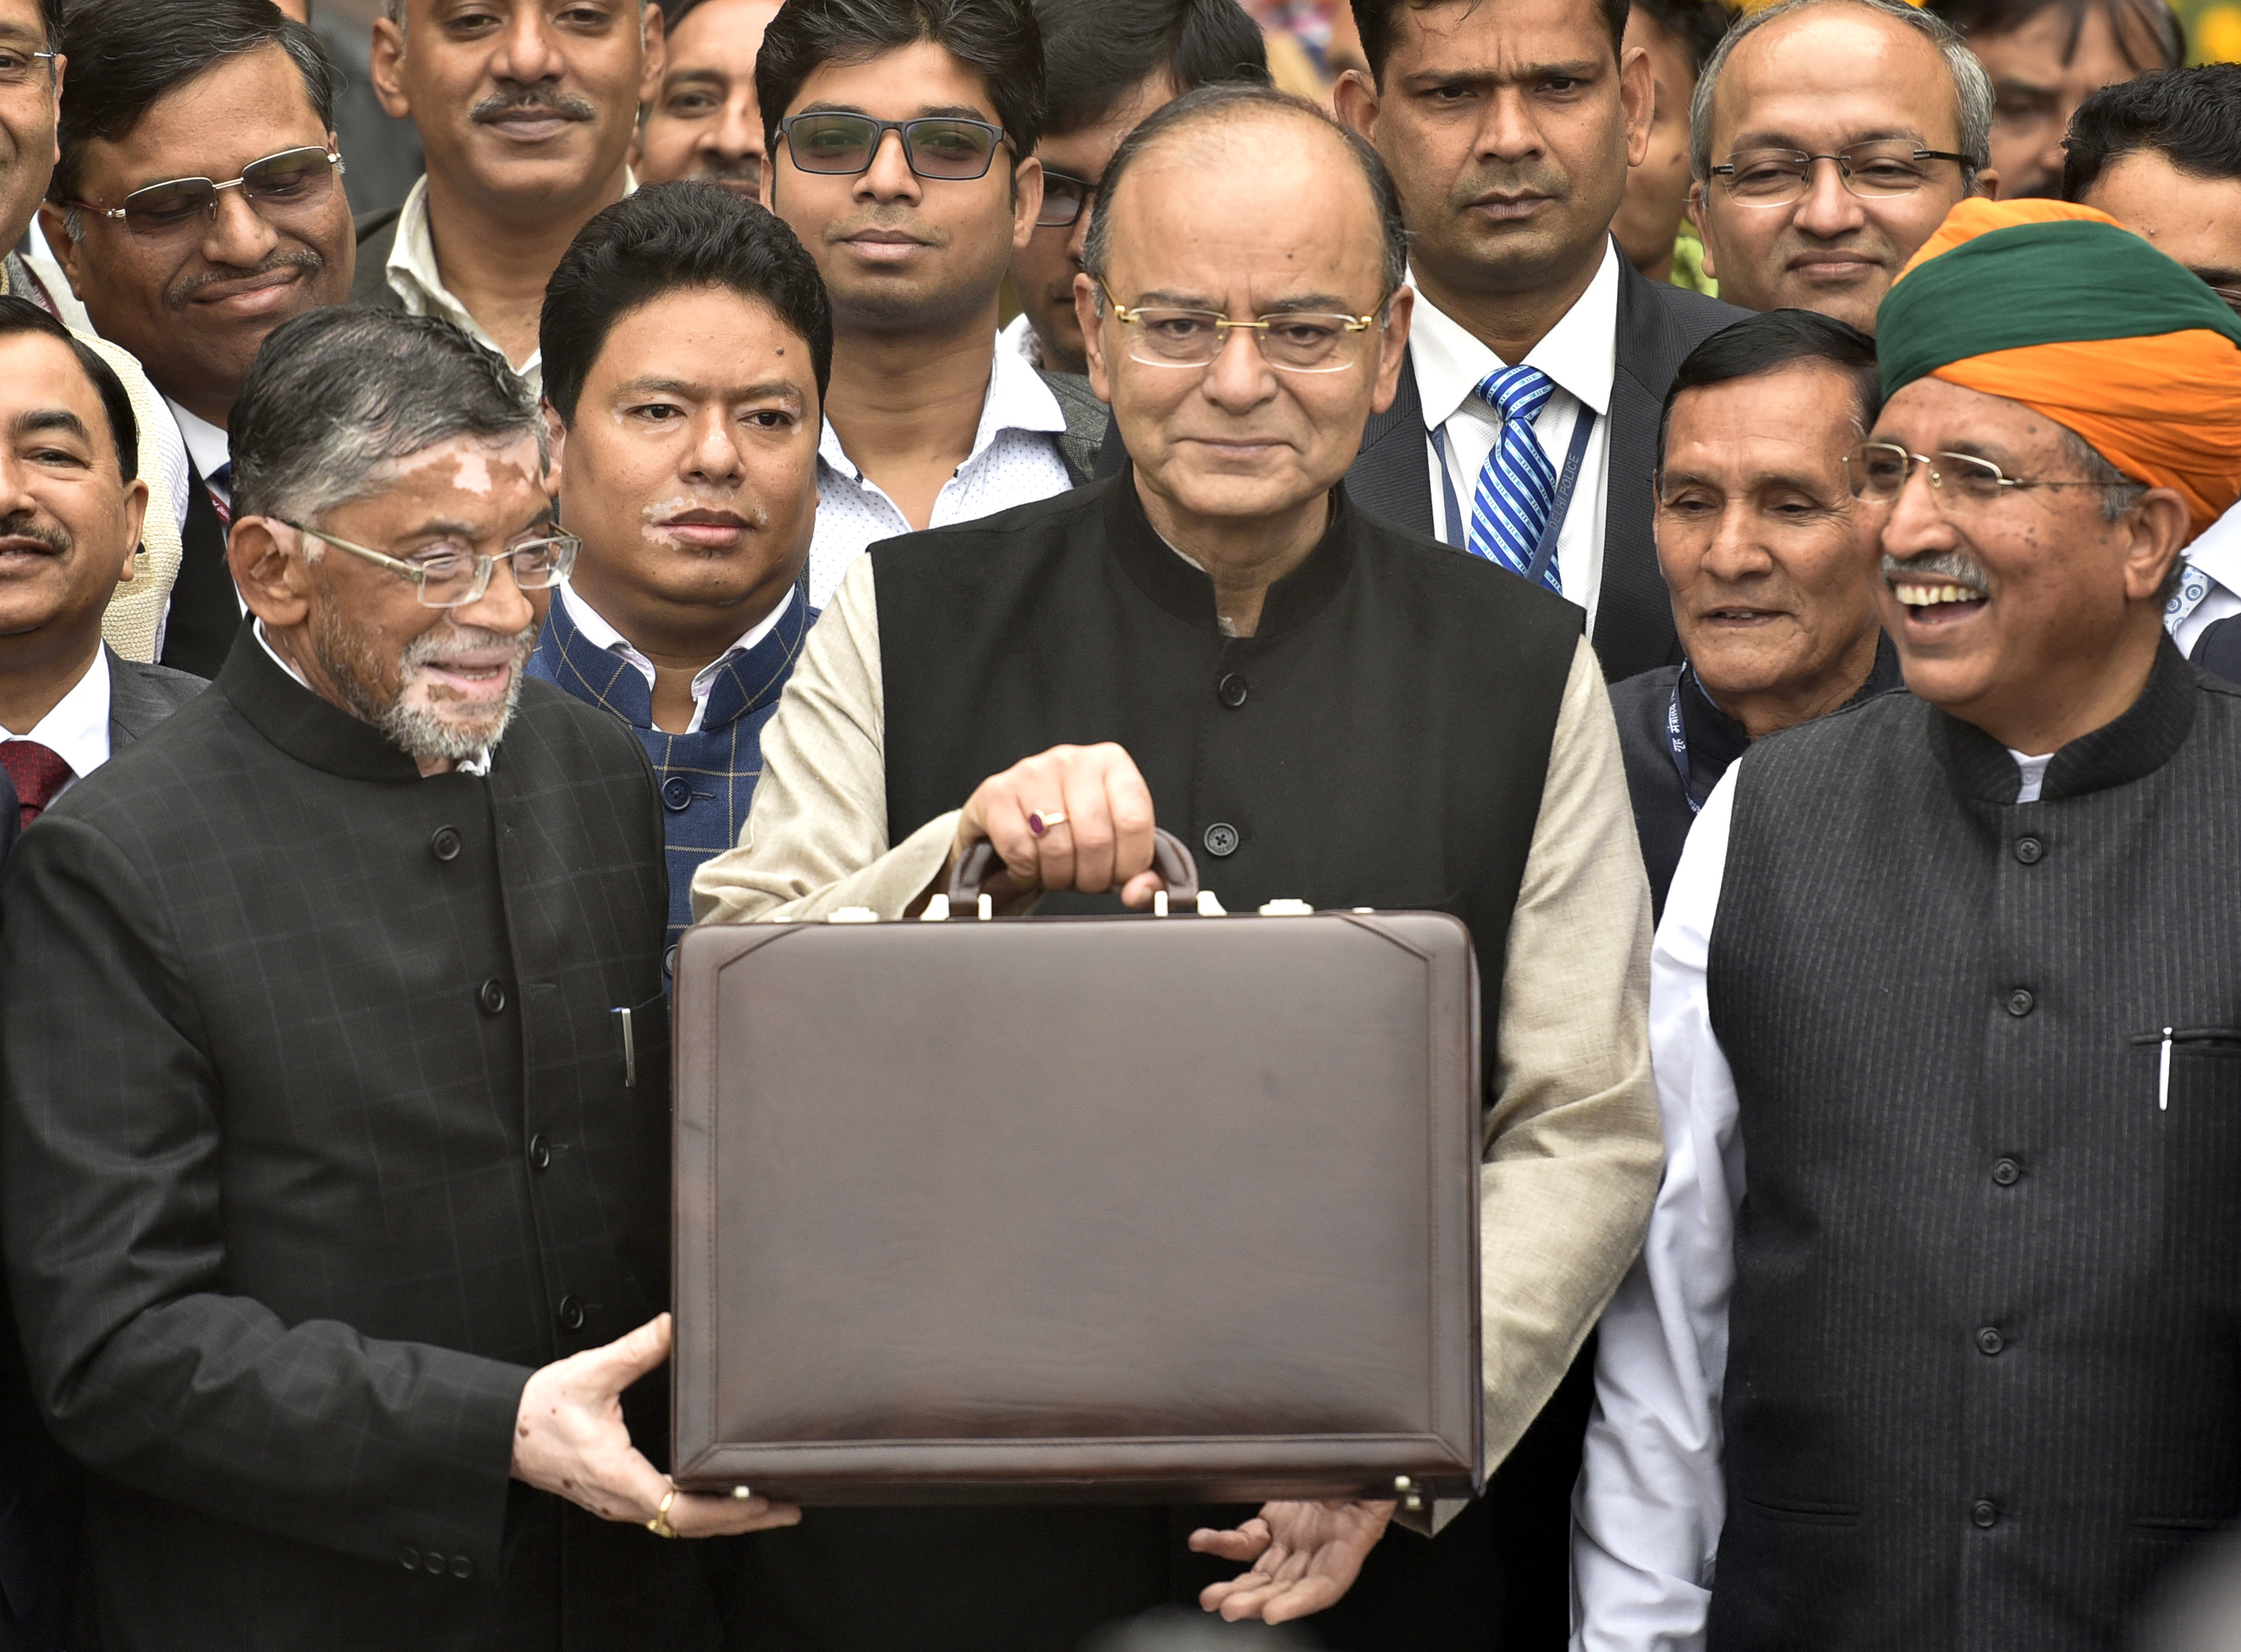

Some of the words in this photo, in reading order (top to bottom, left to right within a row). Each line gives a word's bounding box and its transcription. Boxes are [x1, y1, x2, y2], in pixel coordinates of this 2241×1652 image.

[1550, 494, 1566, 531] DELHI
[1560, 453, 1580, 496] POLICE
[1667, 703, 1680, 733] मंत्रालय
[1672, 738, 1686, 752] गृह
